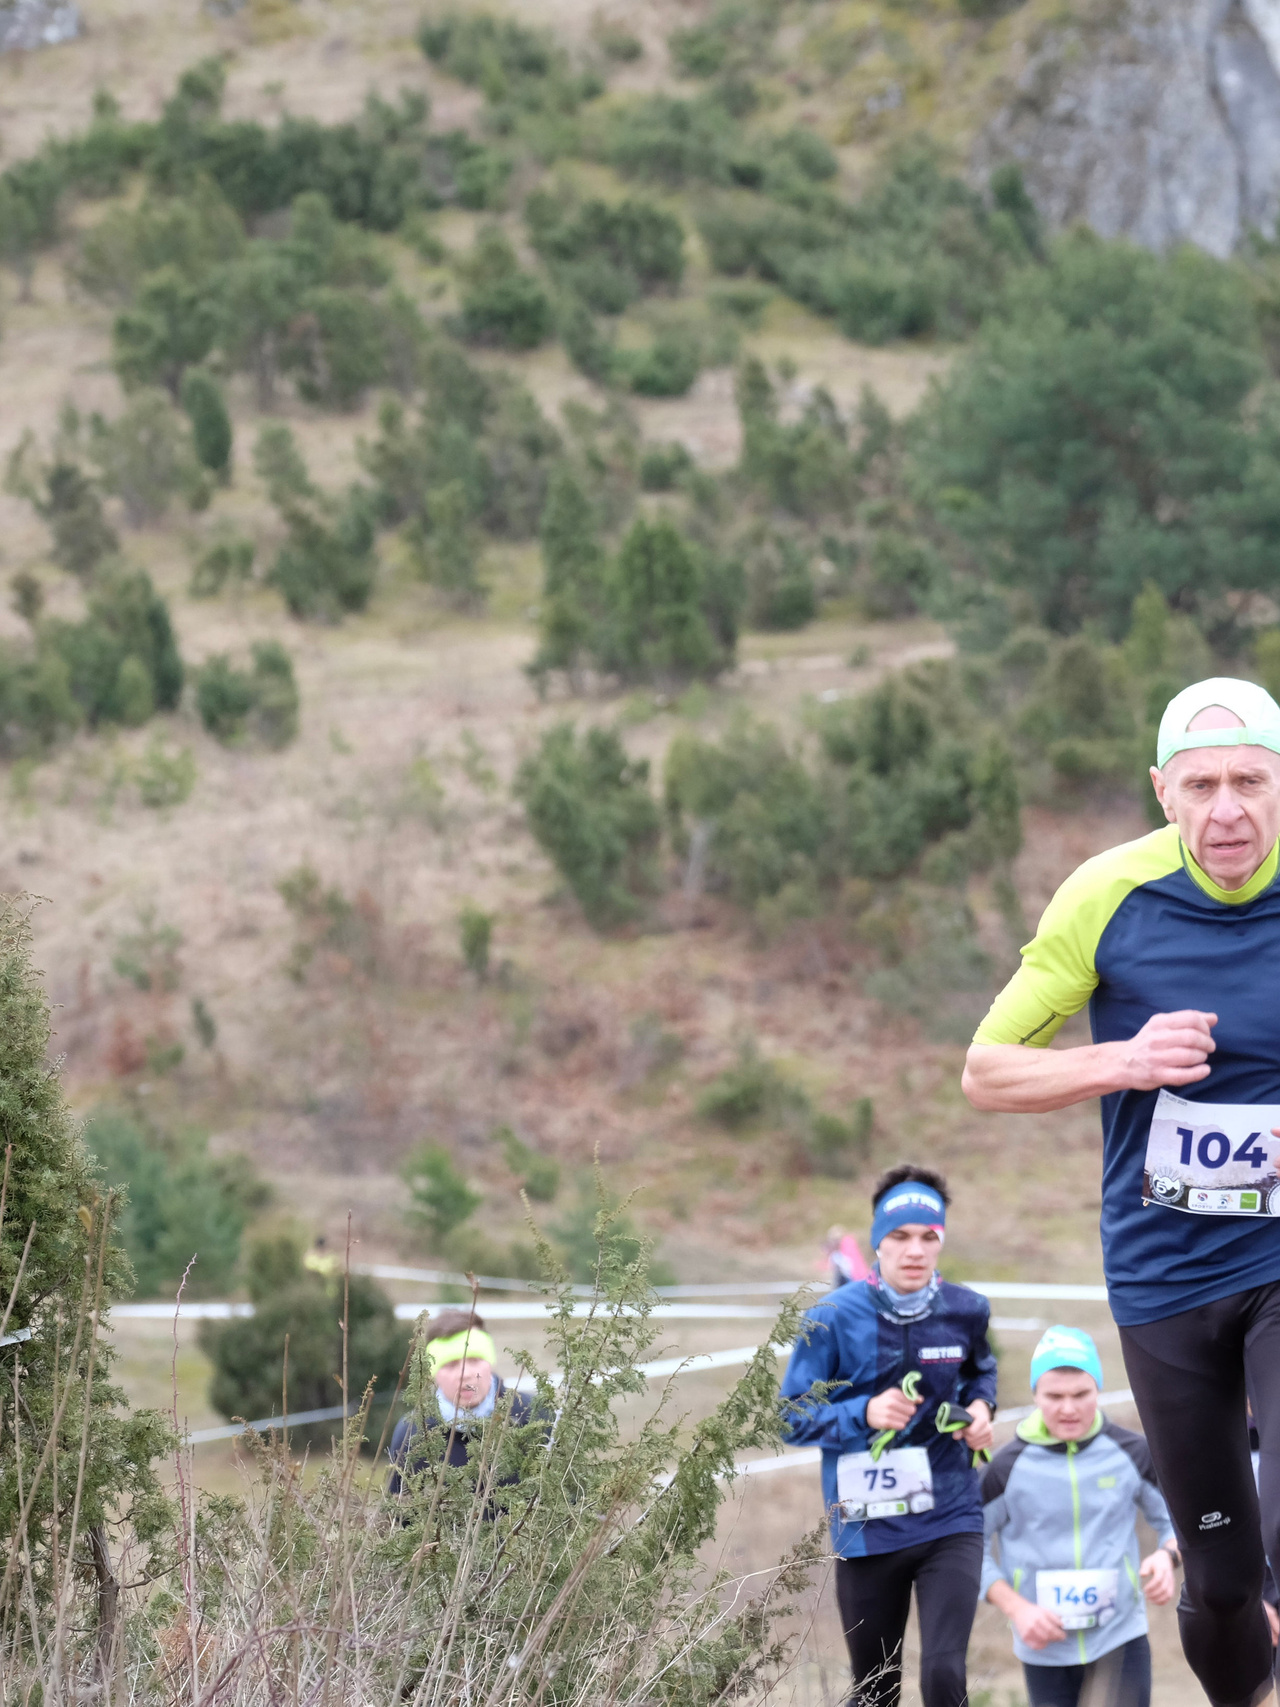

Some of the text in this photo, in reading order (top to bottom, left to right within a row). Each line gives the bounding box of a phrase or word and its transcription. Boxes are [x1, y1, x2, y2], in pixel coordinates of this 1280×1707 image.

[1176, 1126, 1268, 1169] 104
[863, 1468, 897, 1491] 75
[1053, 1586, 1098, 1606] 146
